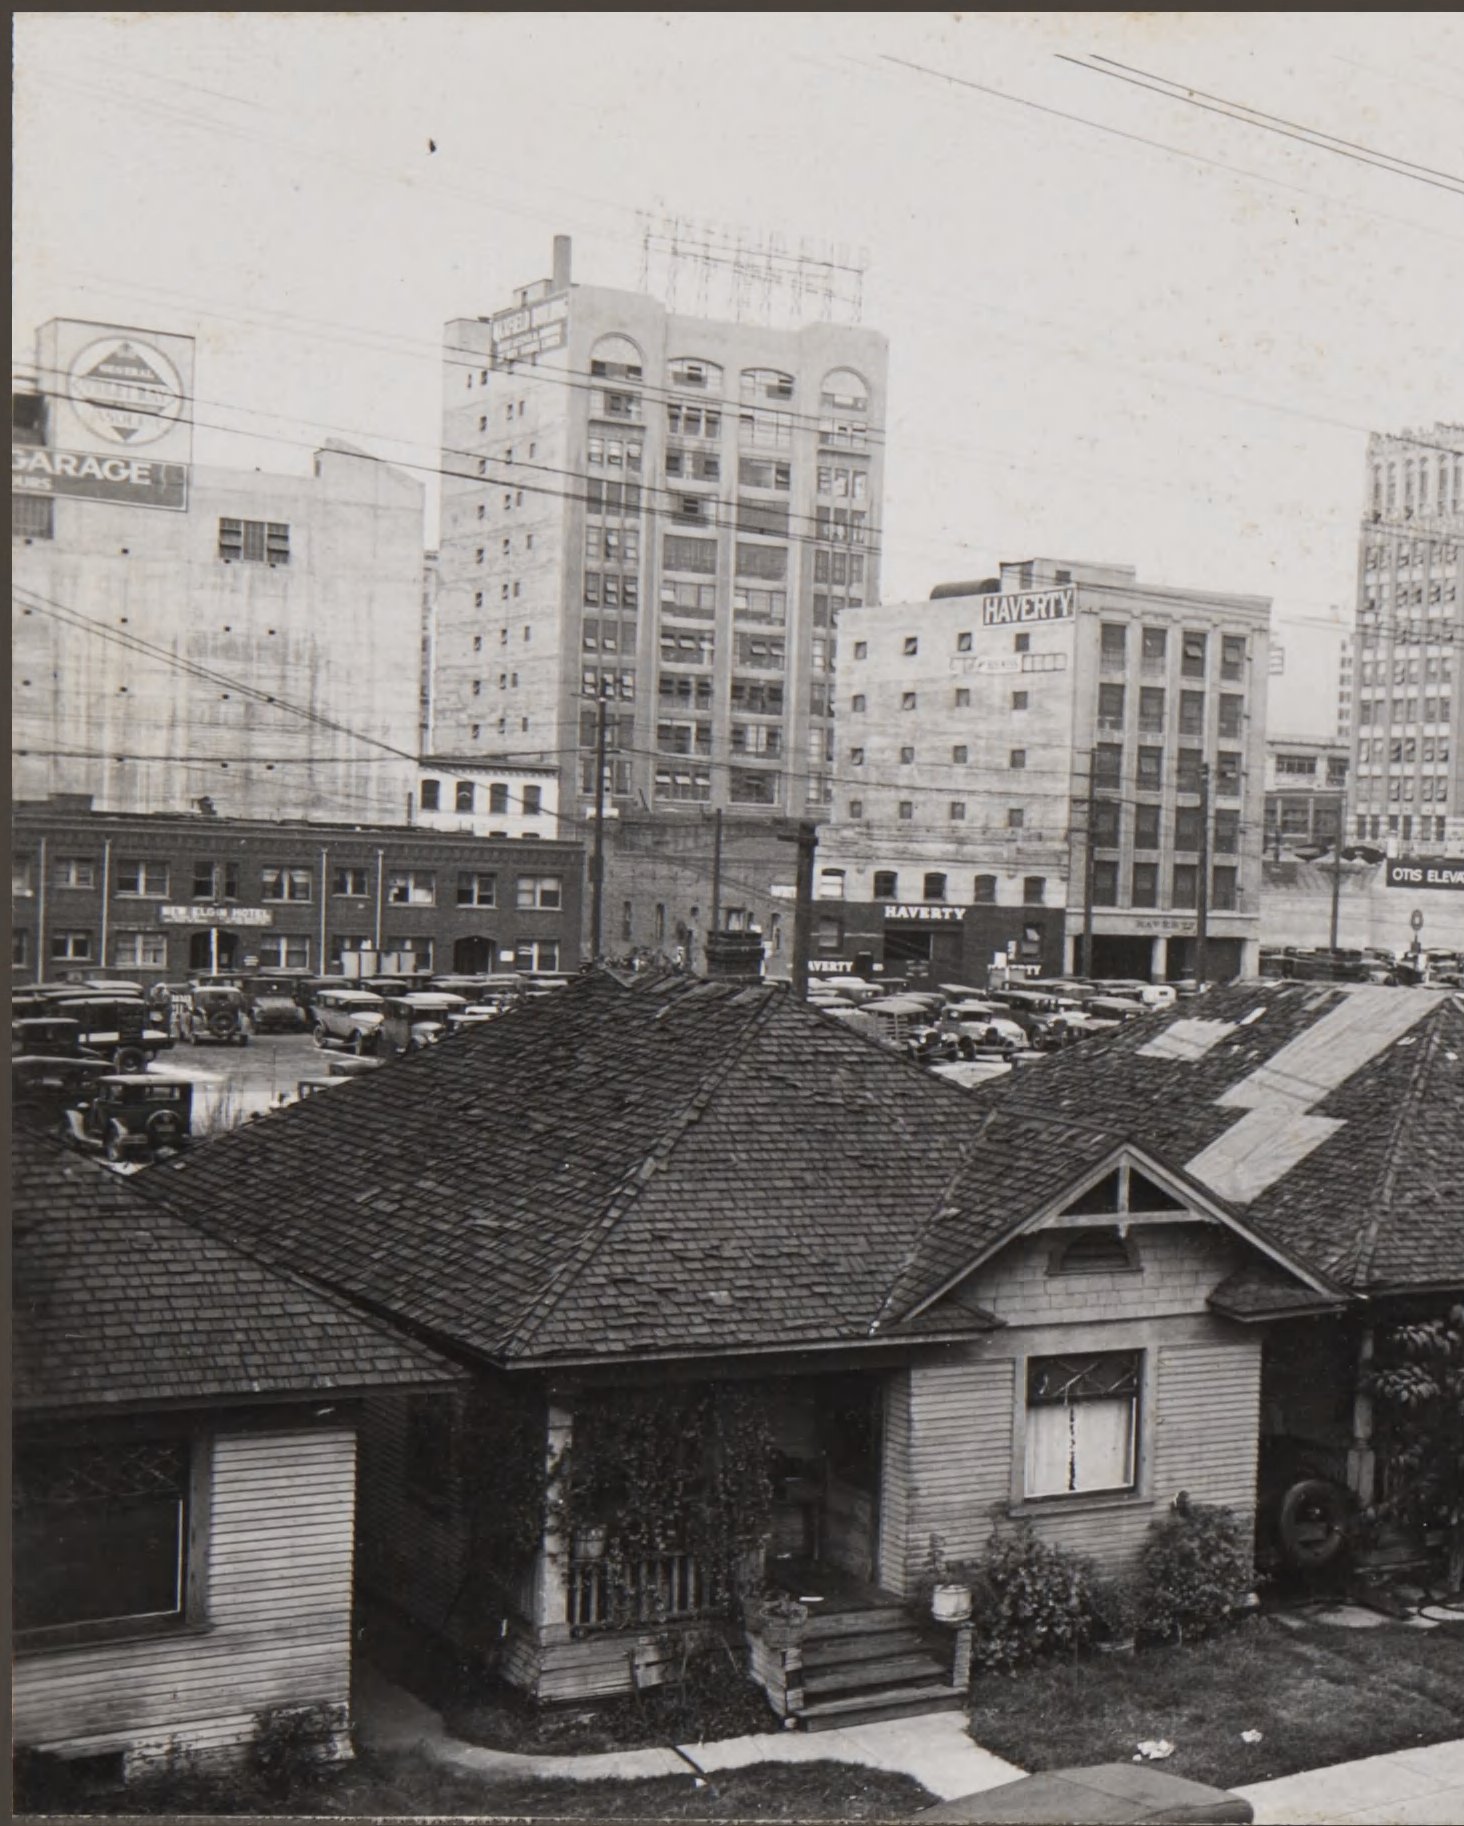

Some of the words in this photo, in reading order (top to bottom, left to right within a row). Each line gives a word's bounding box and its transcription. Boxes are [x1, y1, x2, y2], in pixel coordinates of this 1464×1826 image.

[985, 589, 1072, 625] HAVERTY
[1392, 868, 1423, 882] OTIS
[884, 906, 966, 920] HAVERTY
[808, 961, 854, 972] AVERTY
